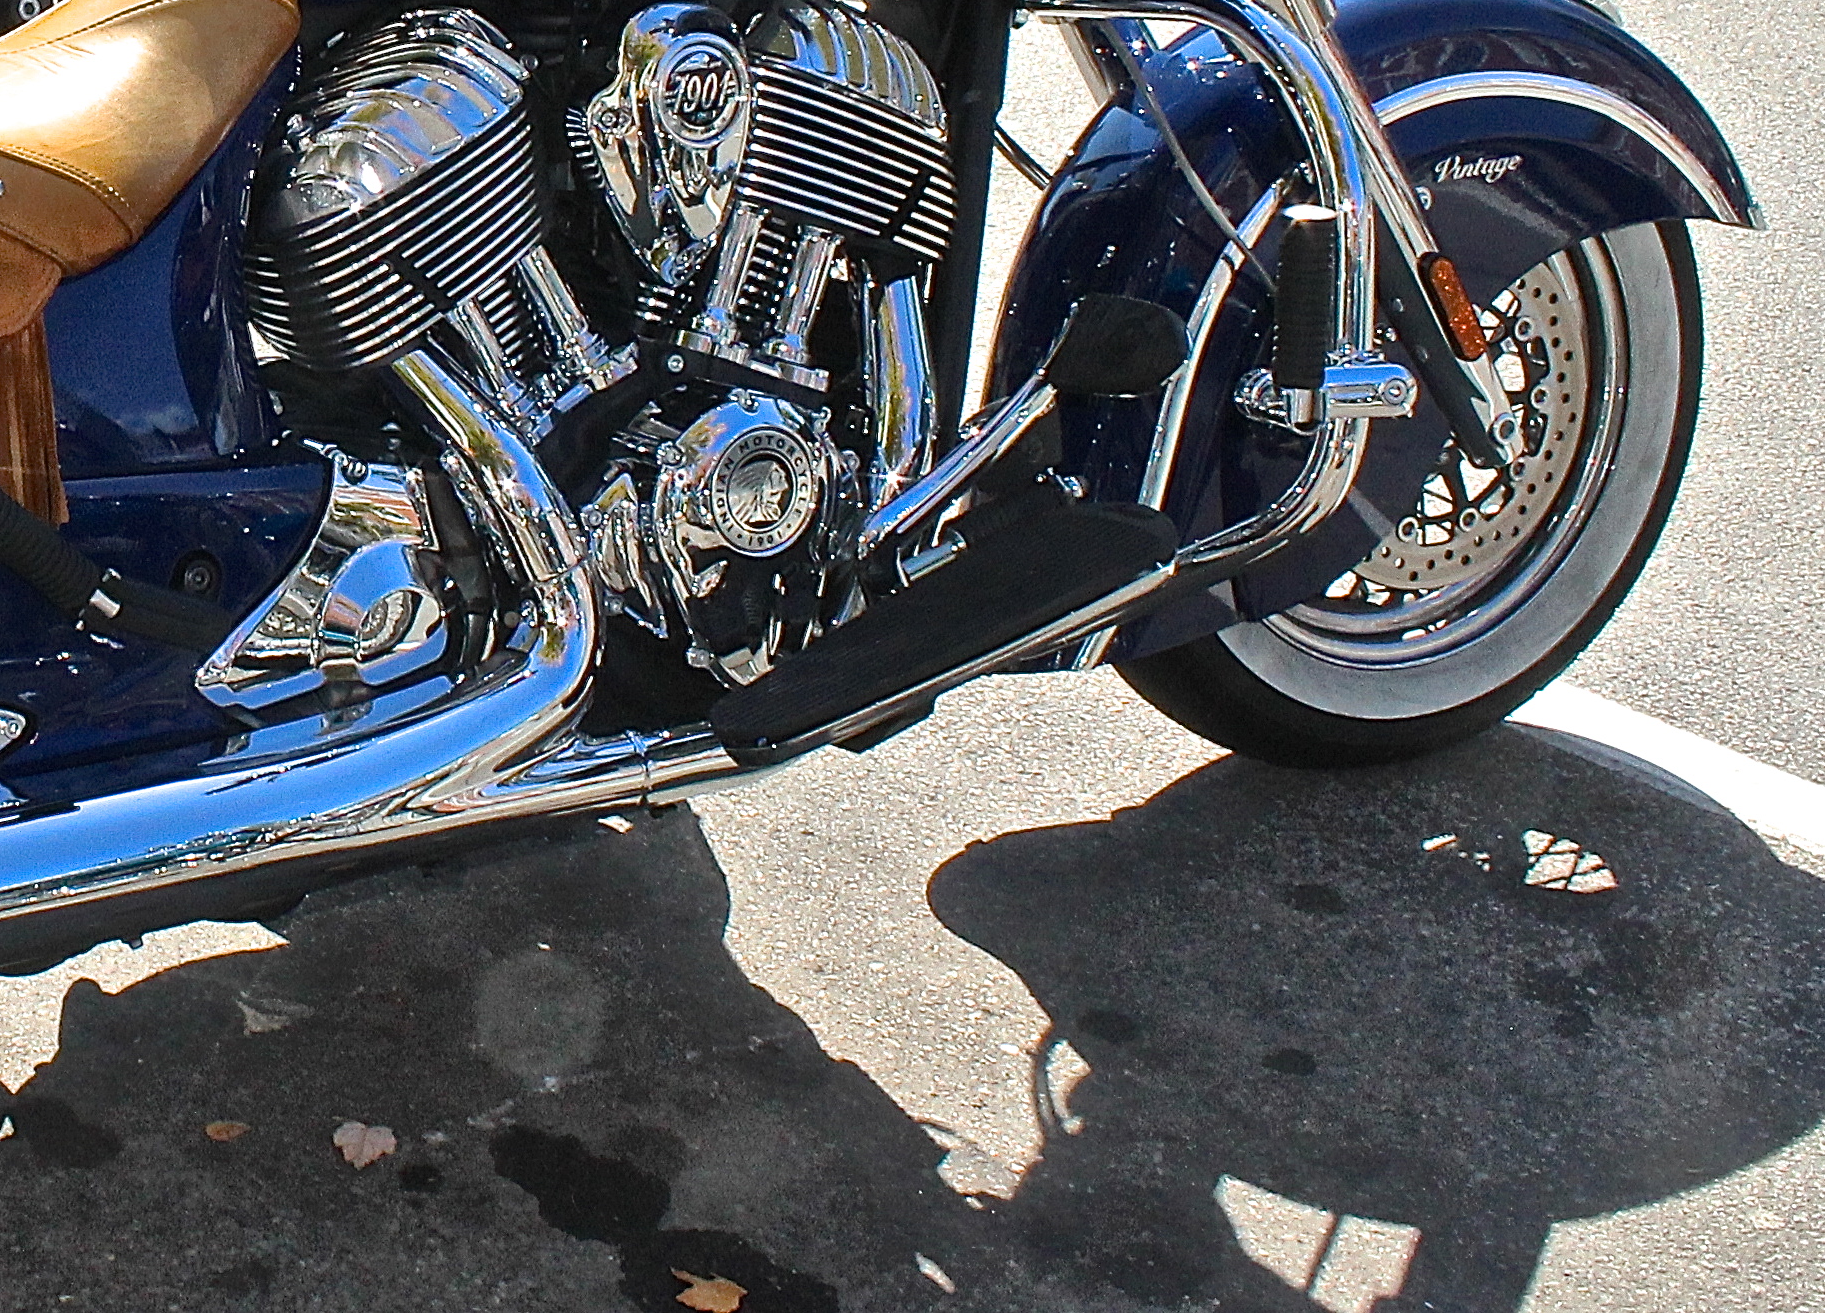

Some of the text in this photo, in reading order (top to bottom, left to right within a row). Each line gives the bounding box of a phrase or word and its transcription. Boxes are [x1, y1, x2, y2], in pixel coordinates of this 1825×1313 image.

[1434, 154, 1523, 184] Vintage
[713, 435, 810, 533] INDIAN MOTORCYCLE
[748, 529, 784, 547] 1901
